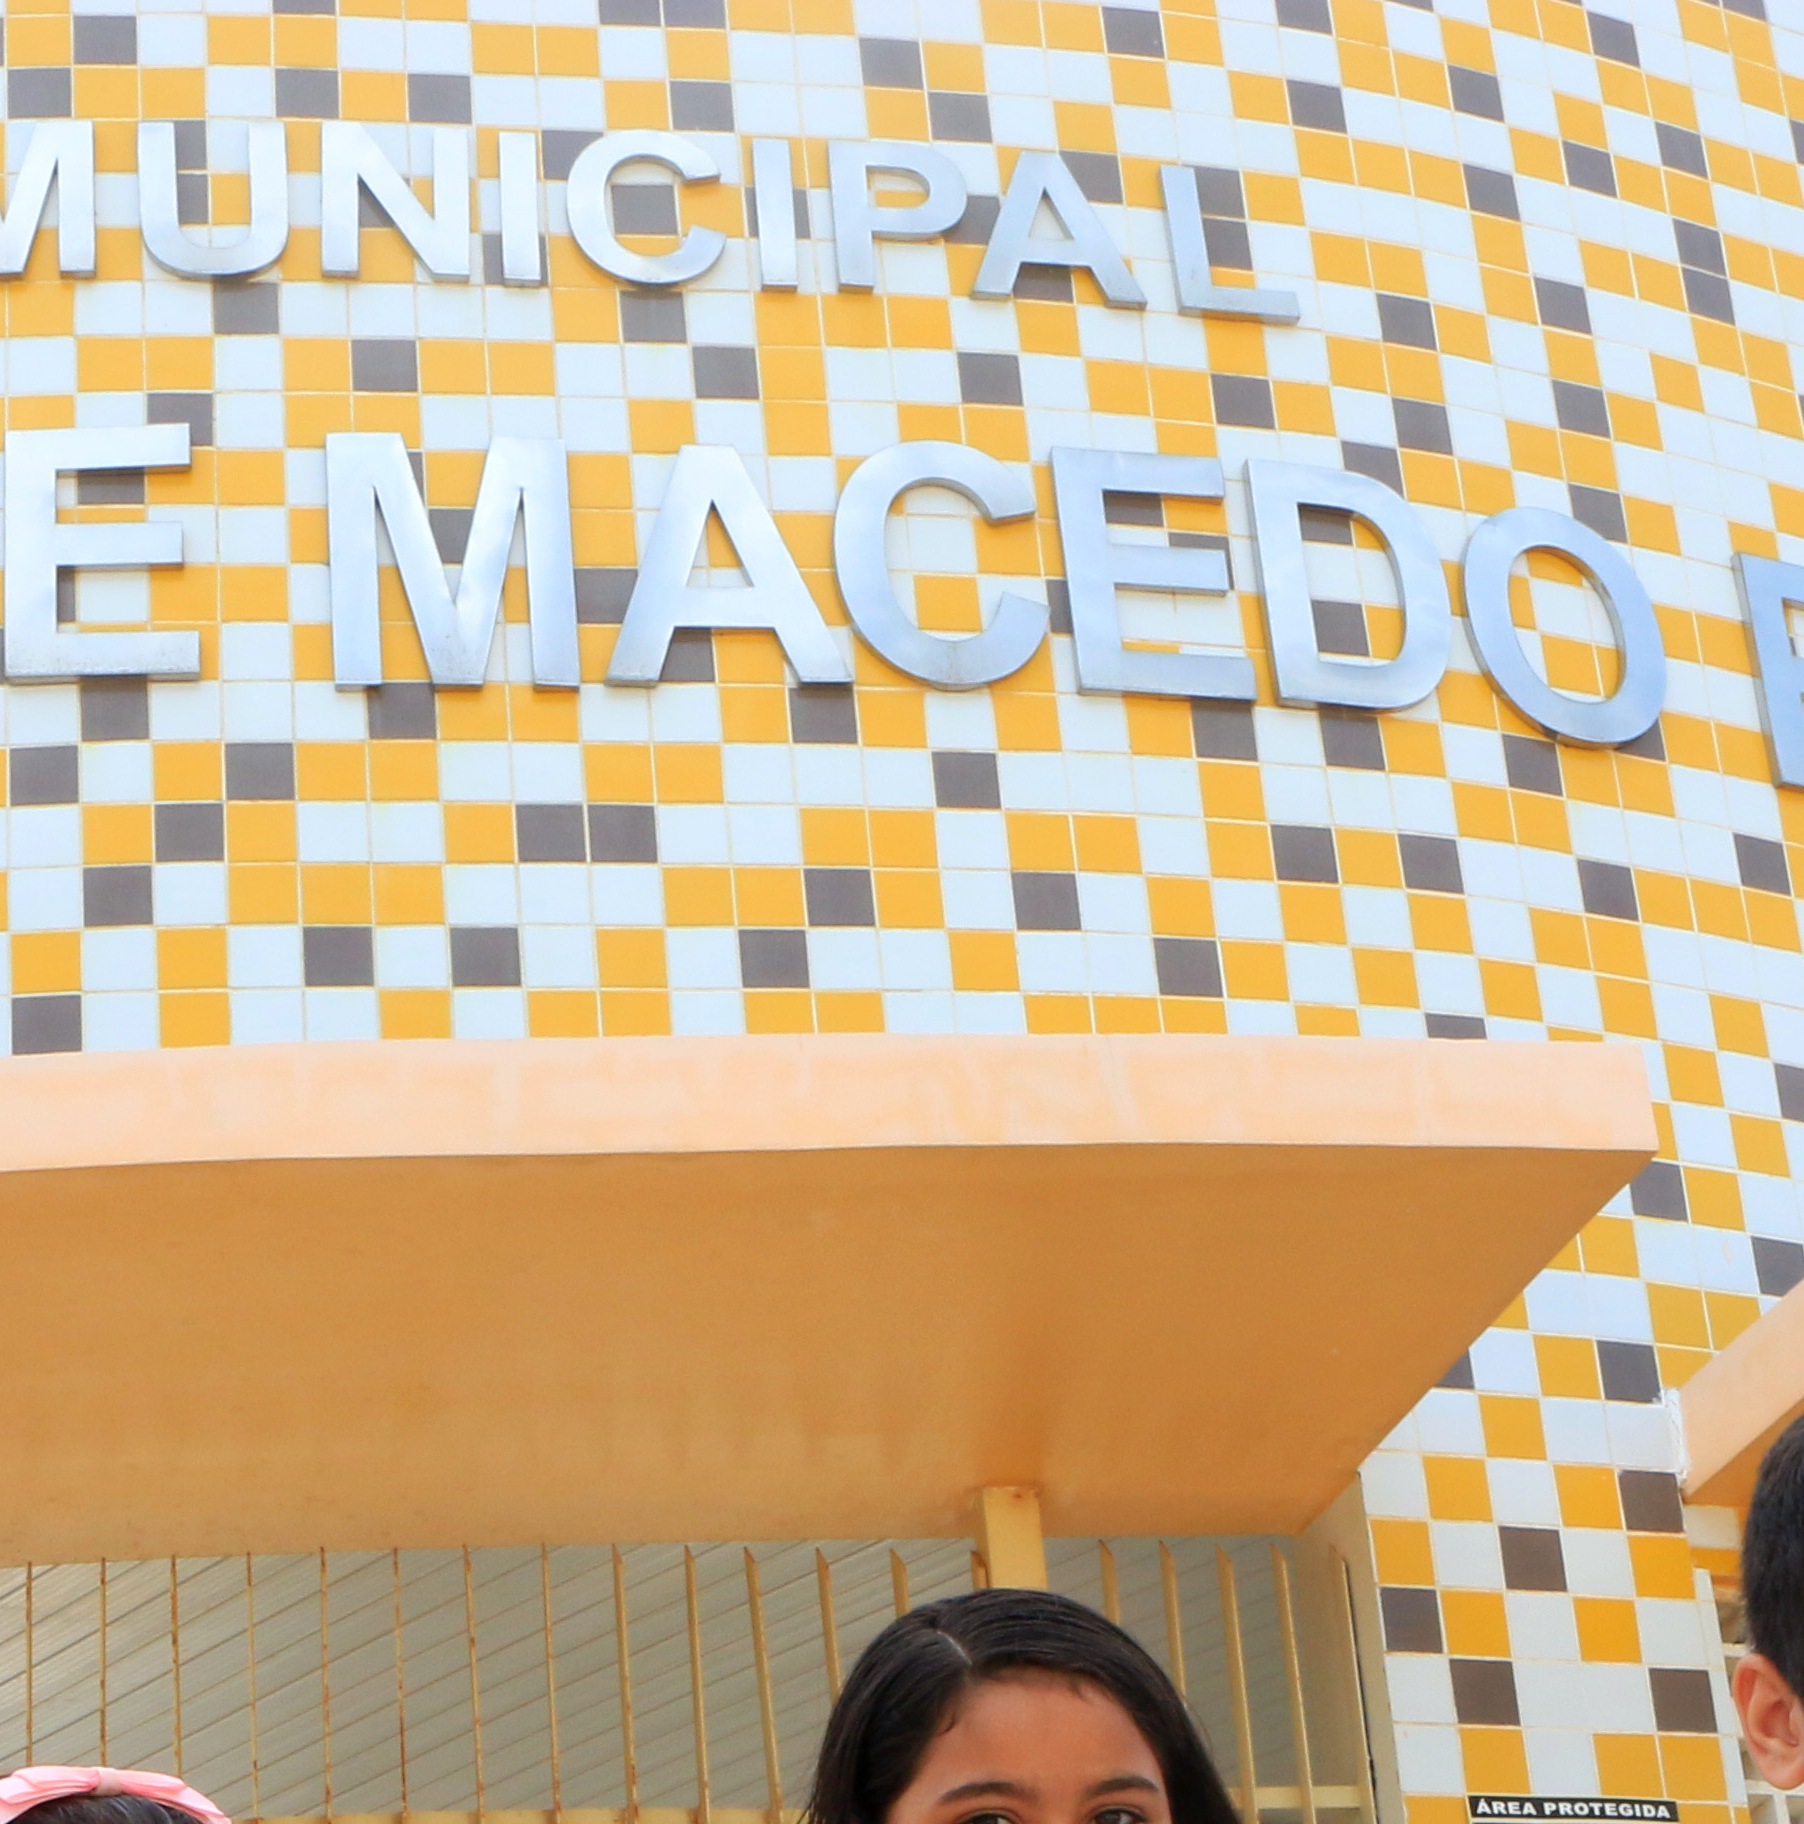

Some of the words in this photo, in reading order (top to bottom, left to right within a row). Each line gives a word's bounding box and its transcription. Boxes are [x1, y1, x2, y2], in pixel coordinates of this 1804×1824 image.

[327, 428, 1668, 751] MACEDO
[1476, 1798, 1537, 1816] ÁREA
[1544, 1802, 1670, 1819] PROTEGIDA
